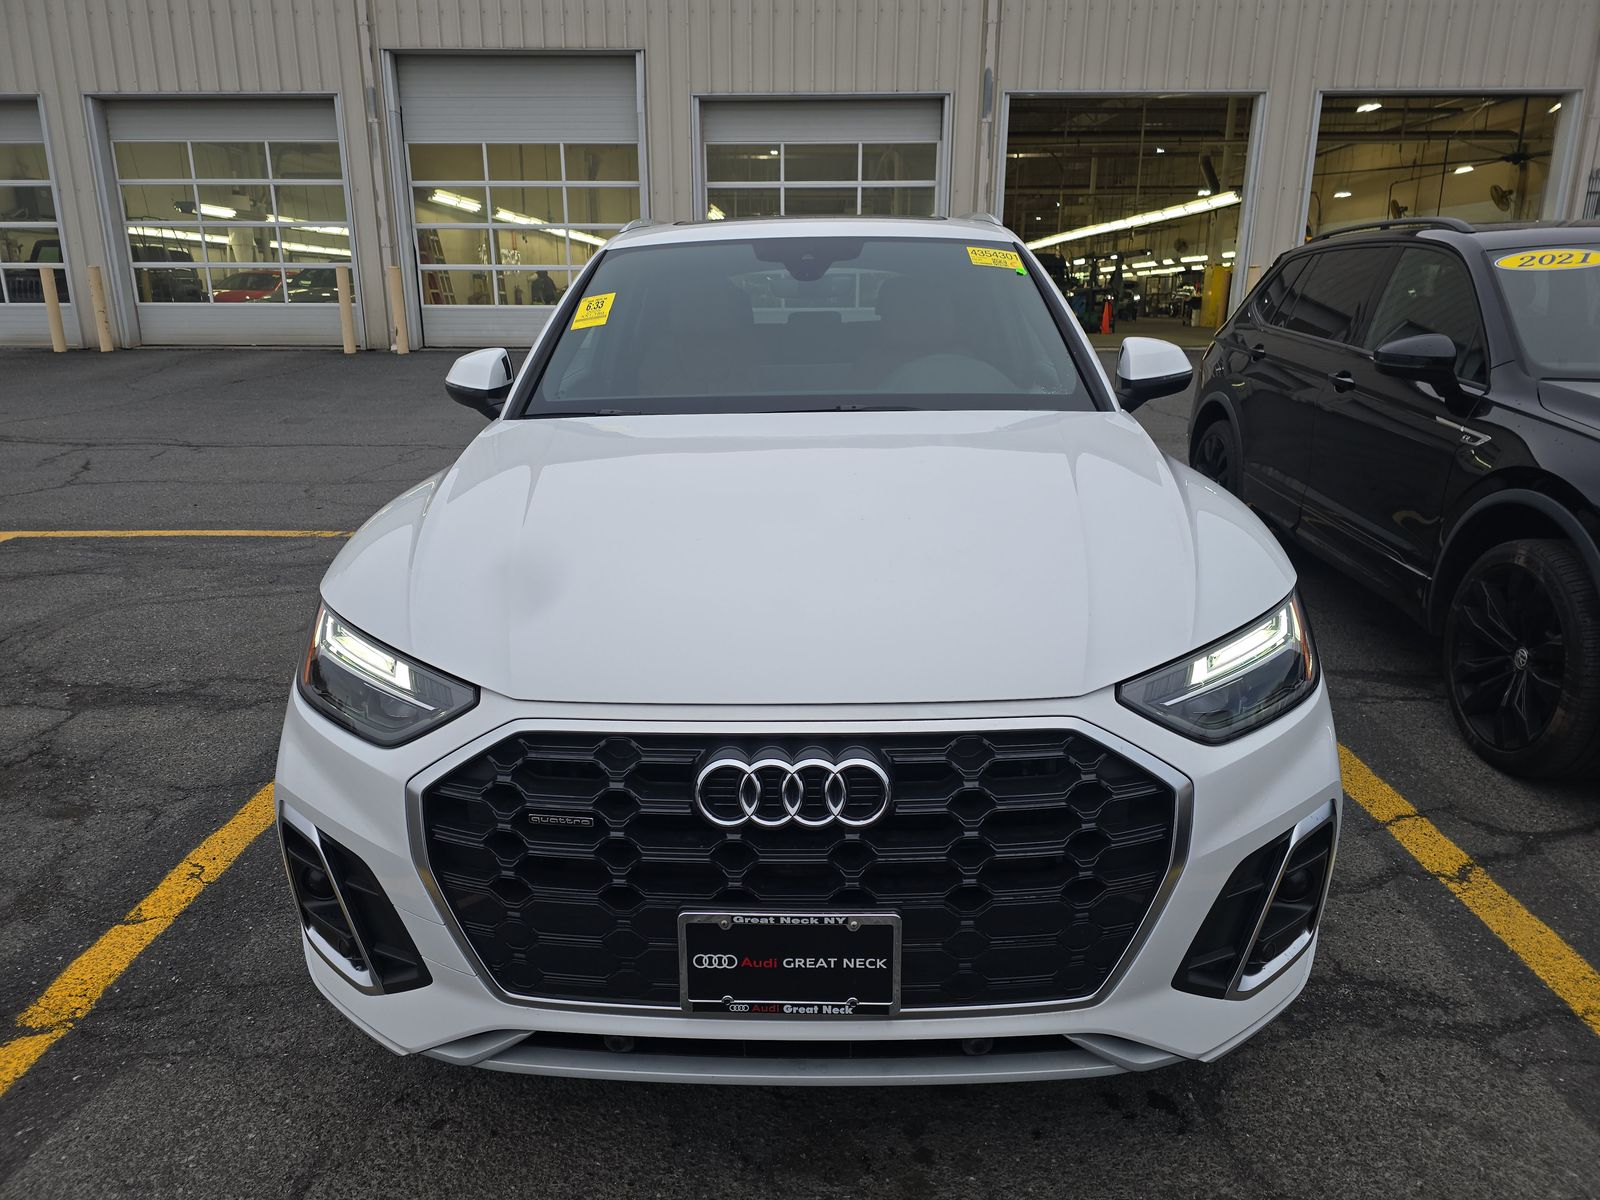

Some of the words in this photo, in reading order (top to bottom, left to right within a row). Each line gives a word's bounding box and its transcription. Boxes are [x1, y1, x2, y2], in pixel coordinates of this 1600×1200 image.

[970, 249, 1019, 261] 4354301
[1518, 252, 1592, 268] 2021
[531, 816, 591, 825] quattro
[733, 916, 775, 924] Great
[779, 917, 820, 925] Neck
[823, 917, 847, 925] NY
[741, 957, 778, 969] Audi
[782, 957, 838, 969] GREAT
[842, 957, 888, 969] NECK
[752, 1003, 780, 1013] Audi
[783, 1004, 819, 1014] Great
[822, 1005, 853, 1015] Neck
